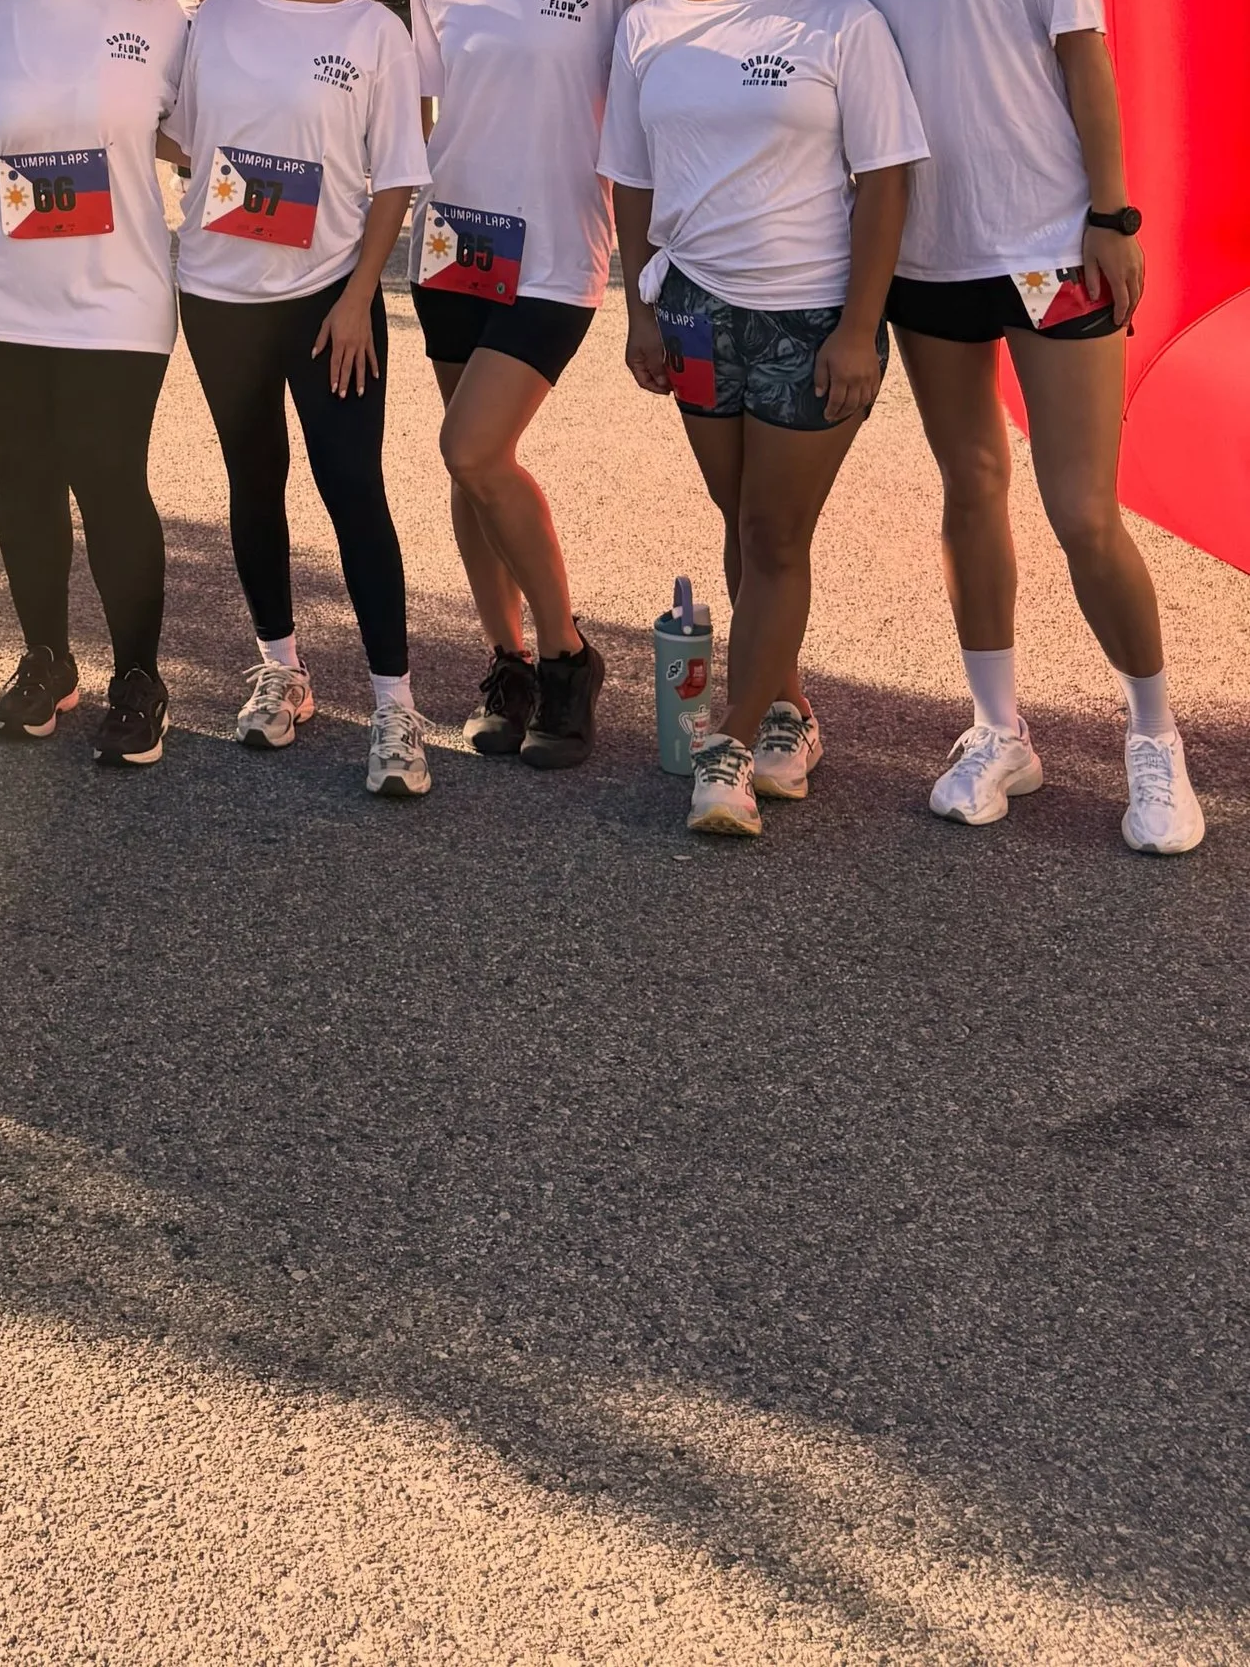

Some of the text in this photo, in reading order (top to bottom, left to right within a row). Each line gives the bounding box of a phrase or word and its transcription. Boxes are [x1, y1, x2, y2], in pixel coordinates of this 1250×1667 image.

[550, 0, 576, 12] FLOW
[106, 32, 150, 51] CORRIDOR
[119, 43, 140, 55] FLOW
[314, 55, 359, 80] CORRIDOR
[324, 66, 350, 82] FLOW
[741, 55, 796, 74] CORRIDOR
[752, 68, 780, 79] FLOW
[14, 152, 89, 168] LUMPIA LAPS
[231, 151, 305, 174] LUMPIA LAPS
[33, 176, 76, 213] 66
[244, 178, 283, 217] 67
[444, 206, 511, 229] LUMPIA LAPS
[457, 231, 494, 272] 65
[671, 312, 695, 328] LAPS
